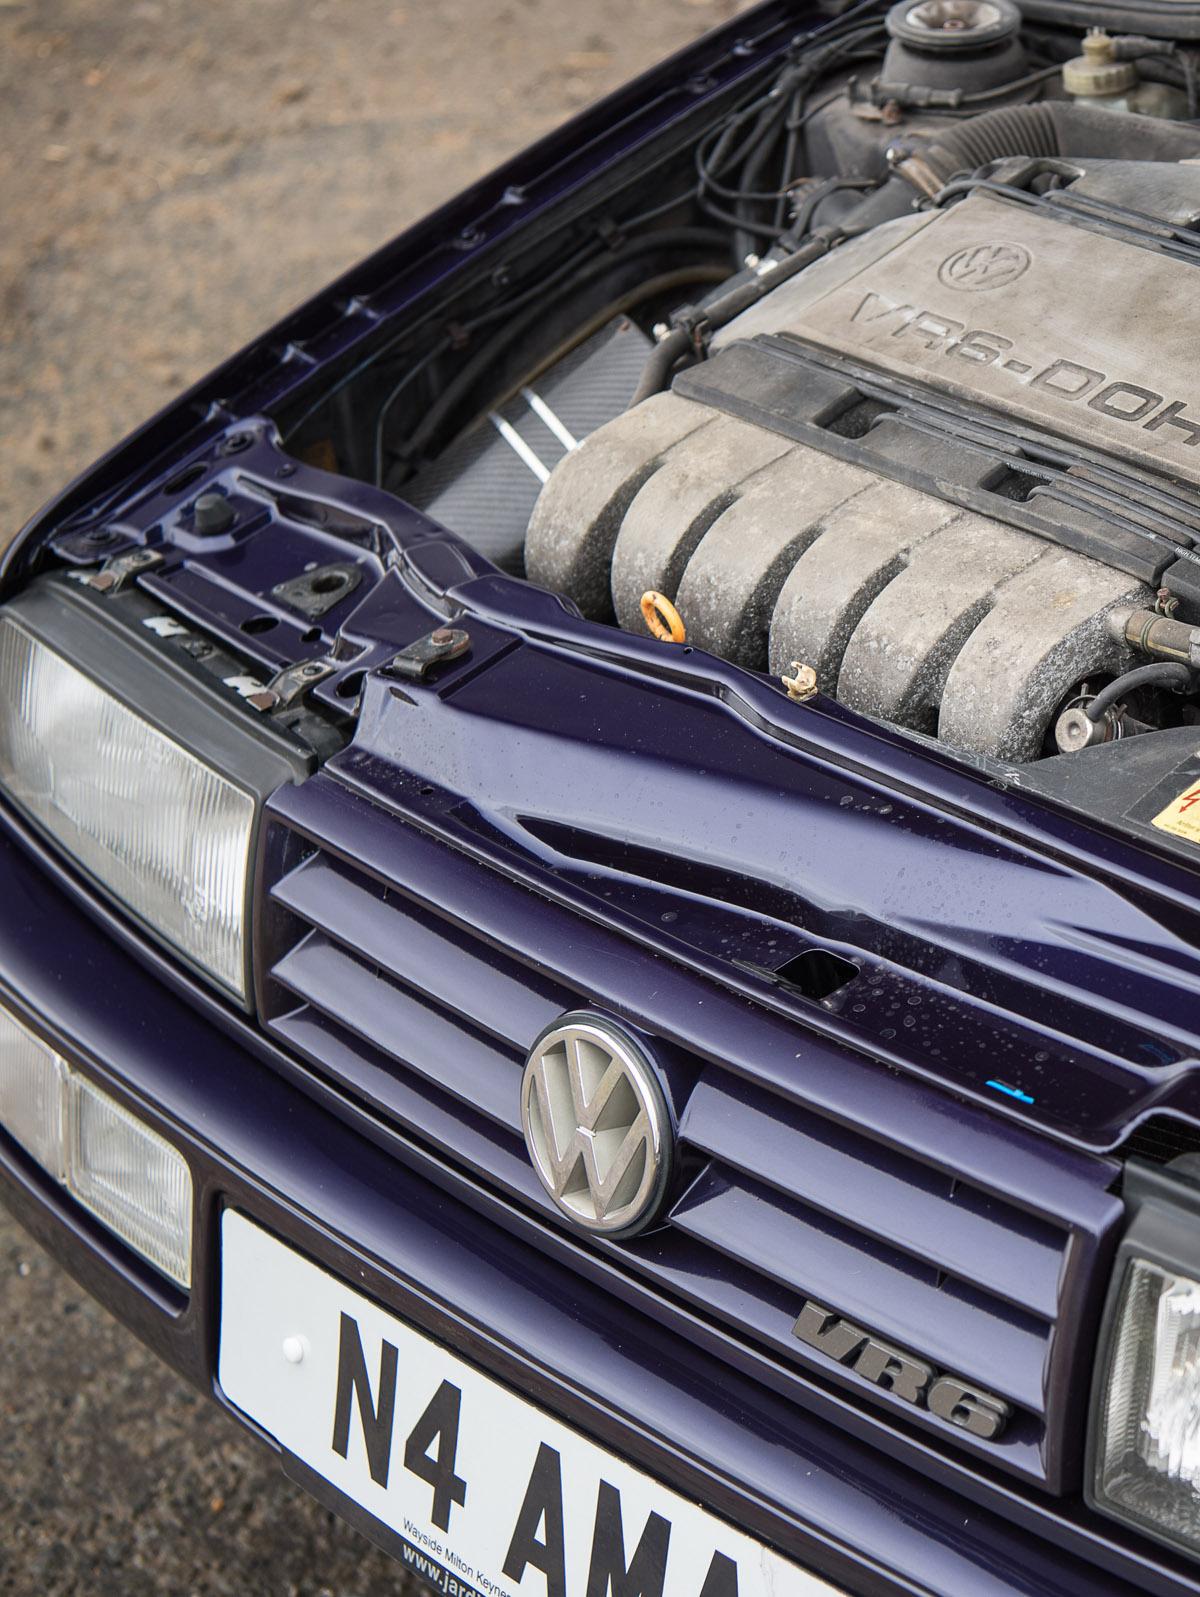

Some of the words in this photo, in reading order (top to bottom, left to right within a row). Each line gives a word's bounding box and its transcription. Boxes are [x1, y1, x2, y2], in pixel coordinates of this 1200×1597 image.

[1175, 546, 1189, 558] HIGH
[791, 1301, 1012, 1440] VR6
[331, 1311, 467, 1534] N4
[403, 1517, 442, 1555] Wayside
[444, 1547, 473, 1578] Milton
